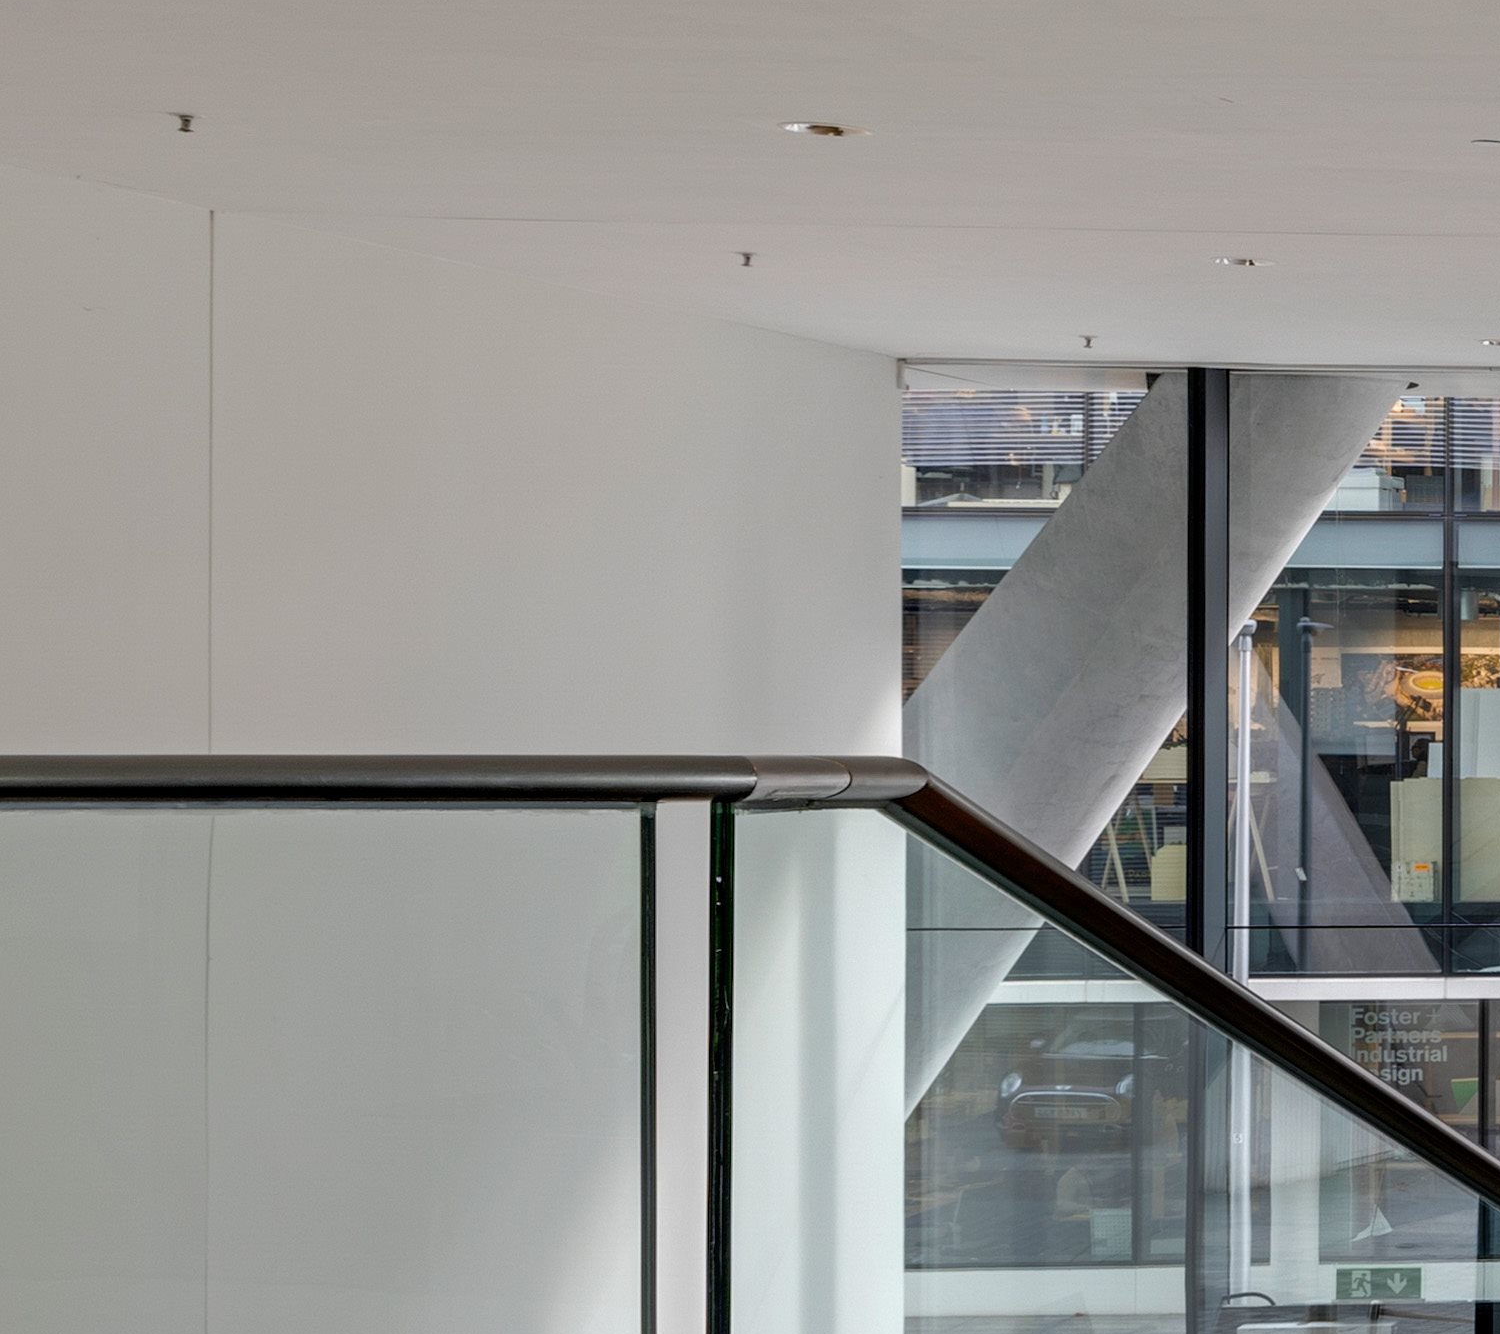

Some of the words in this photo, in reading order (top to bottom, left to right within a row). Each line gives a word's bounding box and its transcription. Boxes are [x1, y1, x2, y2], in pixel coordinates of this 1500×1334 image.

[1351, 1007, 1421, 1025] Foster
[1351, 1027, 1442, 1044] Partners
[1350, 1045, 1448, 1062] Industrial
[1378, 1065, 1424, 1085] sign
